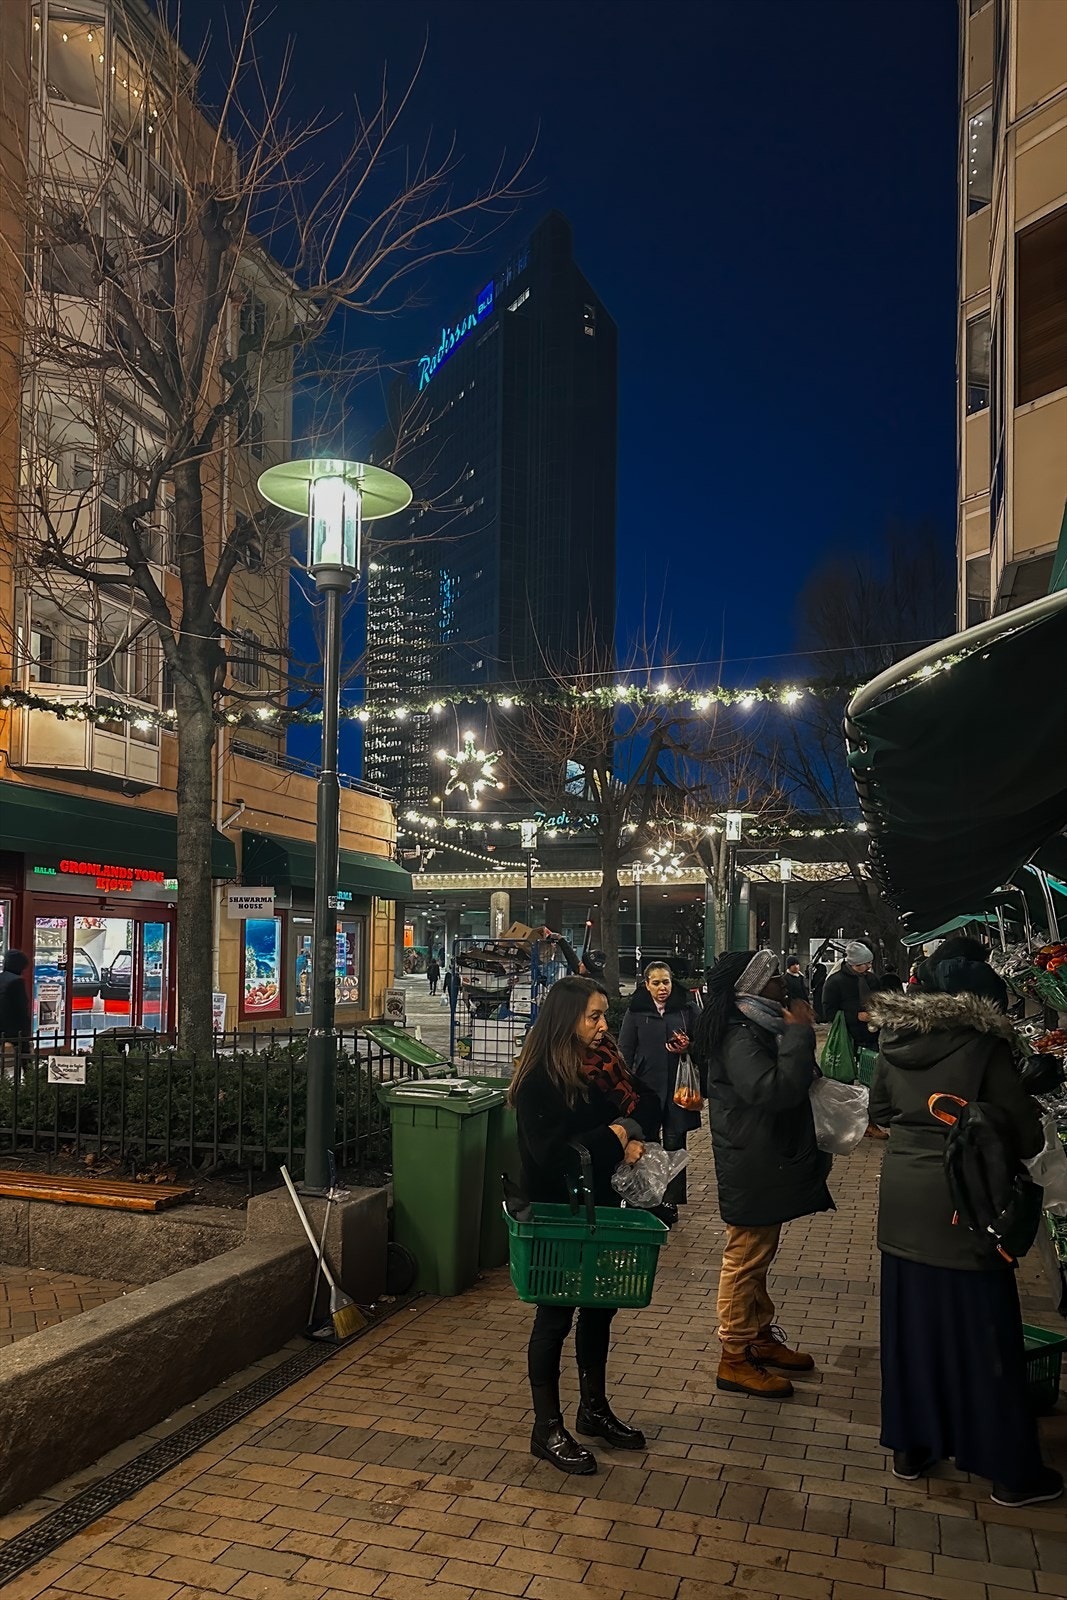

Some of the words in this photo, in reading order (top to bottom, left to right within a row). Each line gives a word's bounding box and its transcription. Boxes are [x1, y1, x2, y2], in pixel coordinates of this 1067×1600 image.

[418, 314, 477, 390] Radisson
[478, 293, 493, 314] BLU
[34, 866, 56, 875] HALAL
[134, 869, 164, 882] TORG
